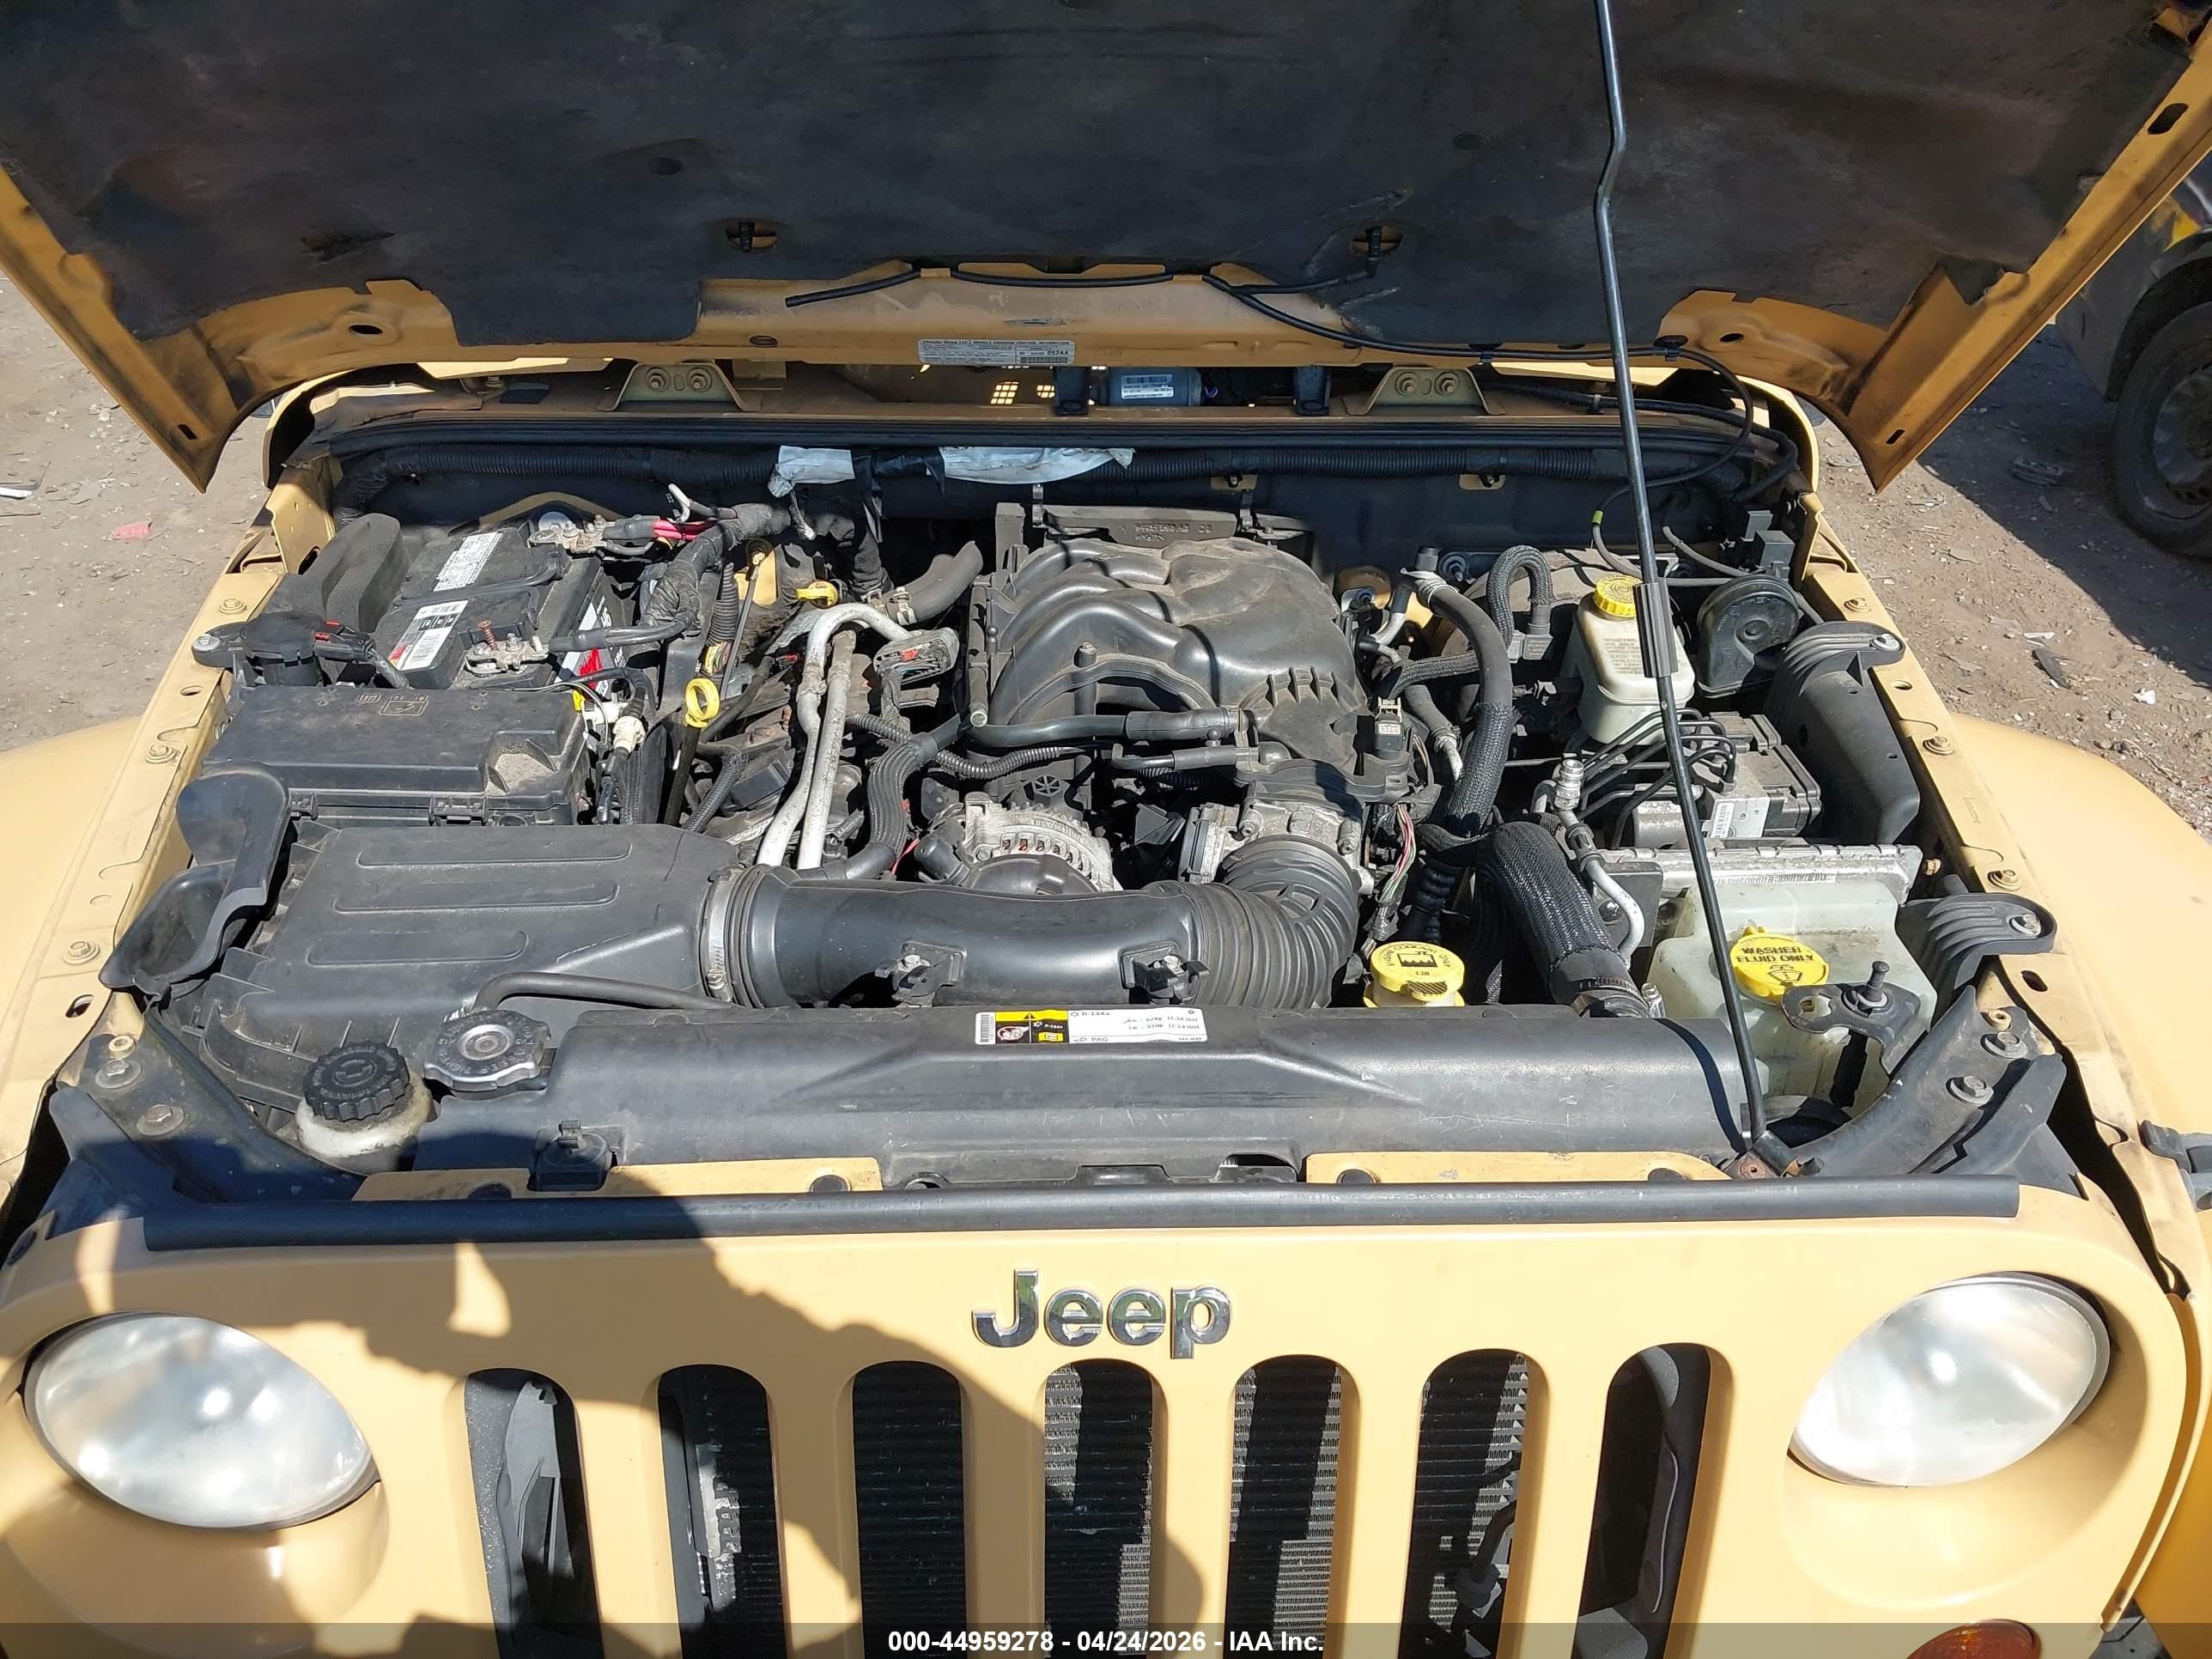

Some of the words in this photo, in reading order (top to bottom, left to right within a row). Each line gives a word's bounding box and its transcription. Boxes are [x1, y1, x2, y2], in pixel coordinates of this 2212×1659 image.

[1741, 946, 1802, 955] WASHER
[1779, 954, 1814, 963] ONLY
[971, 1268, 1232, 1359] Jeep
